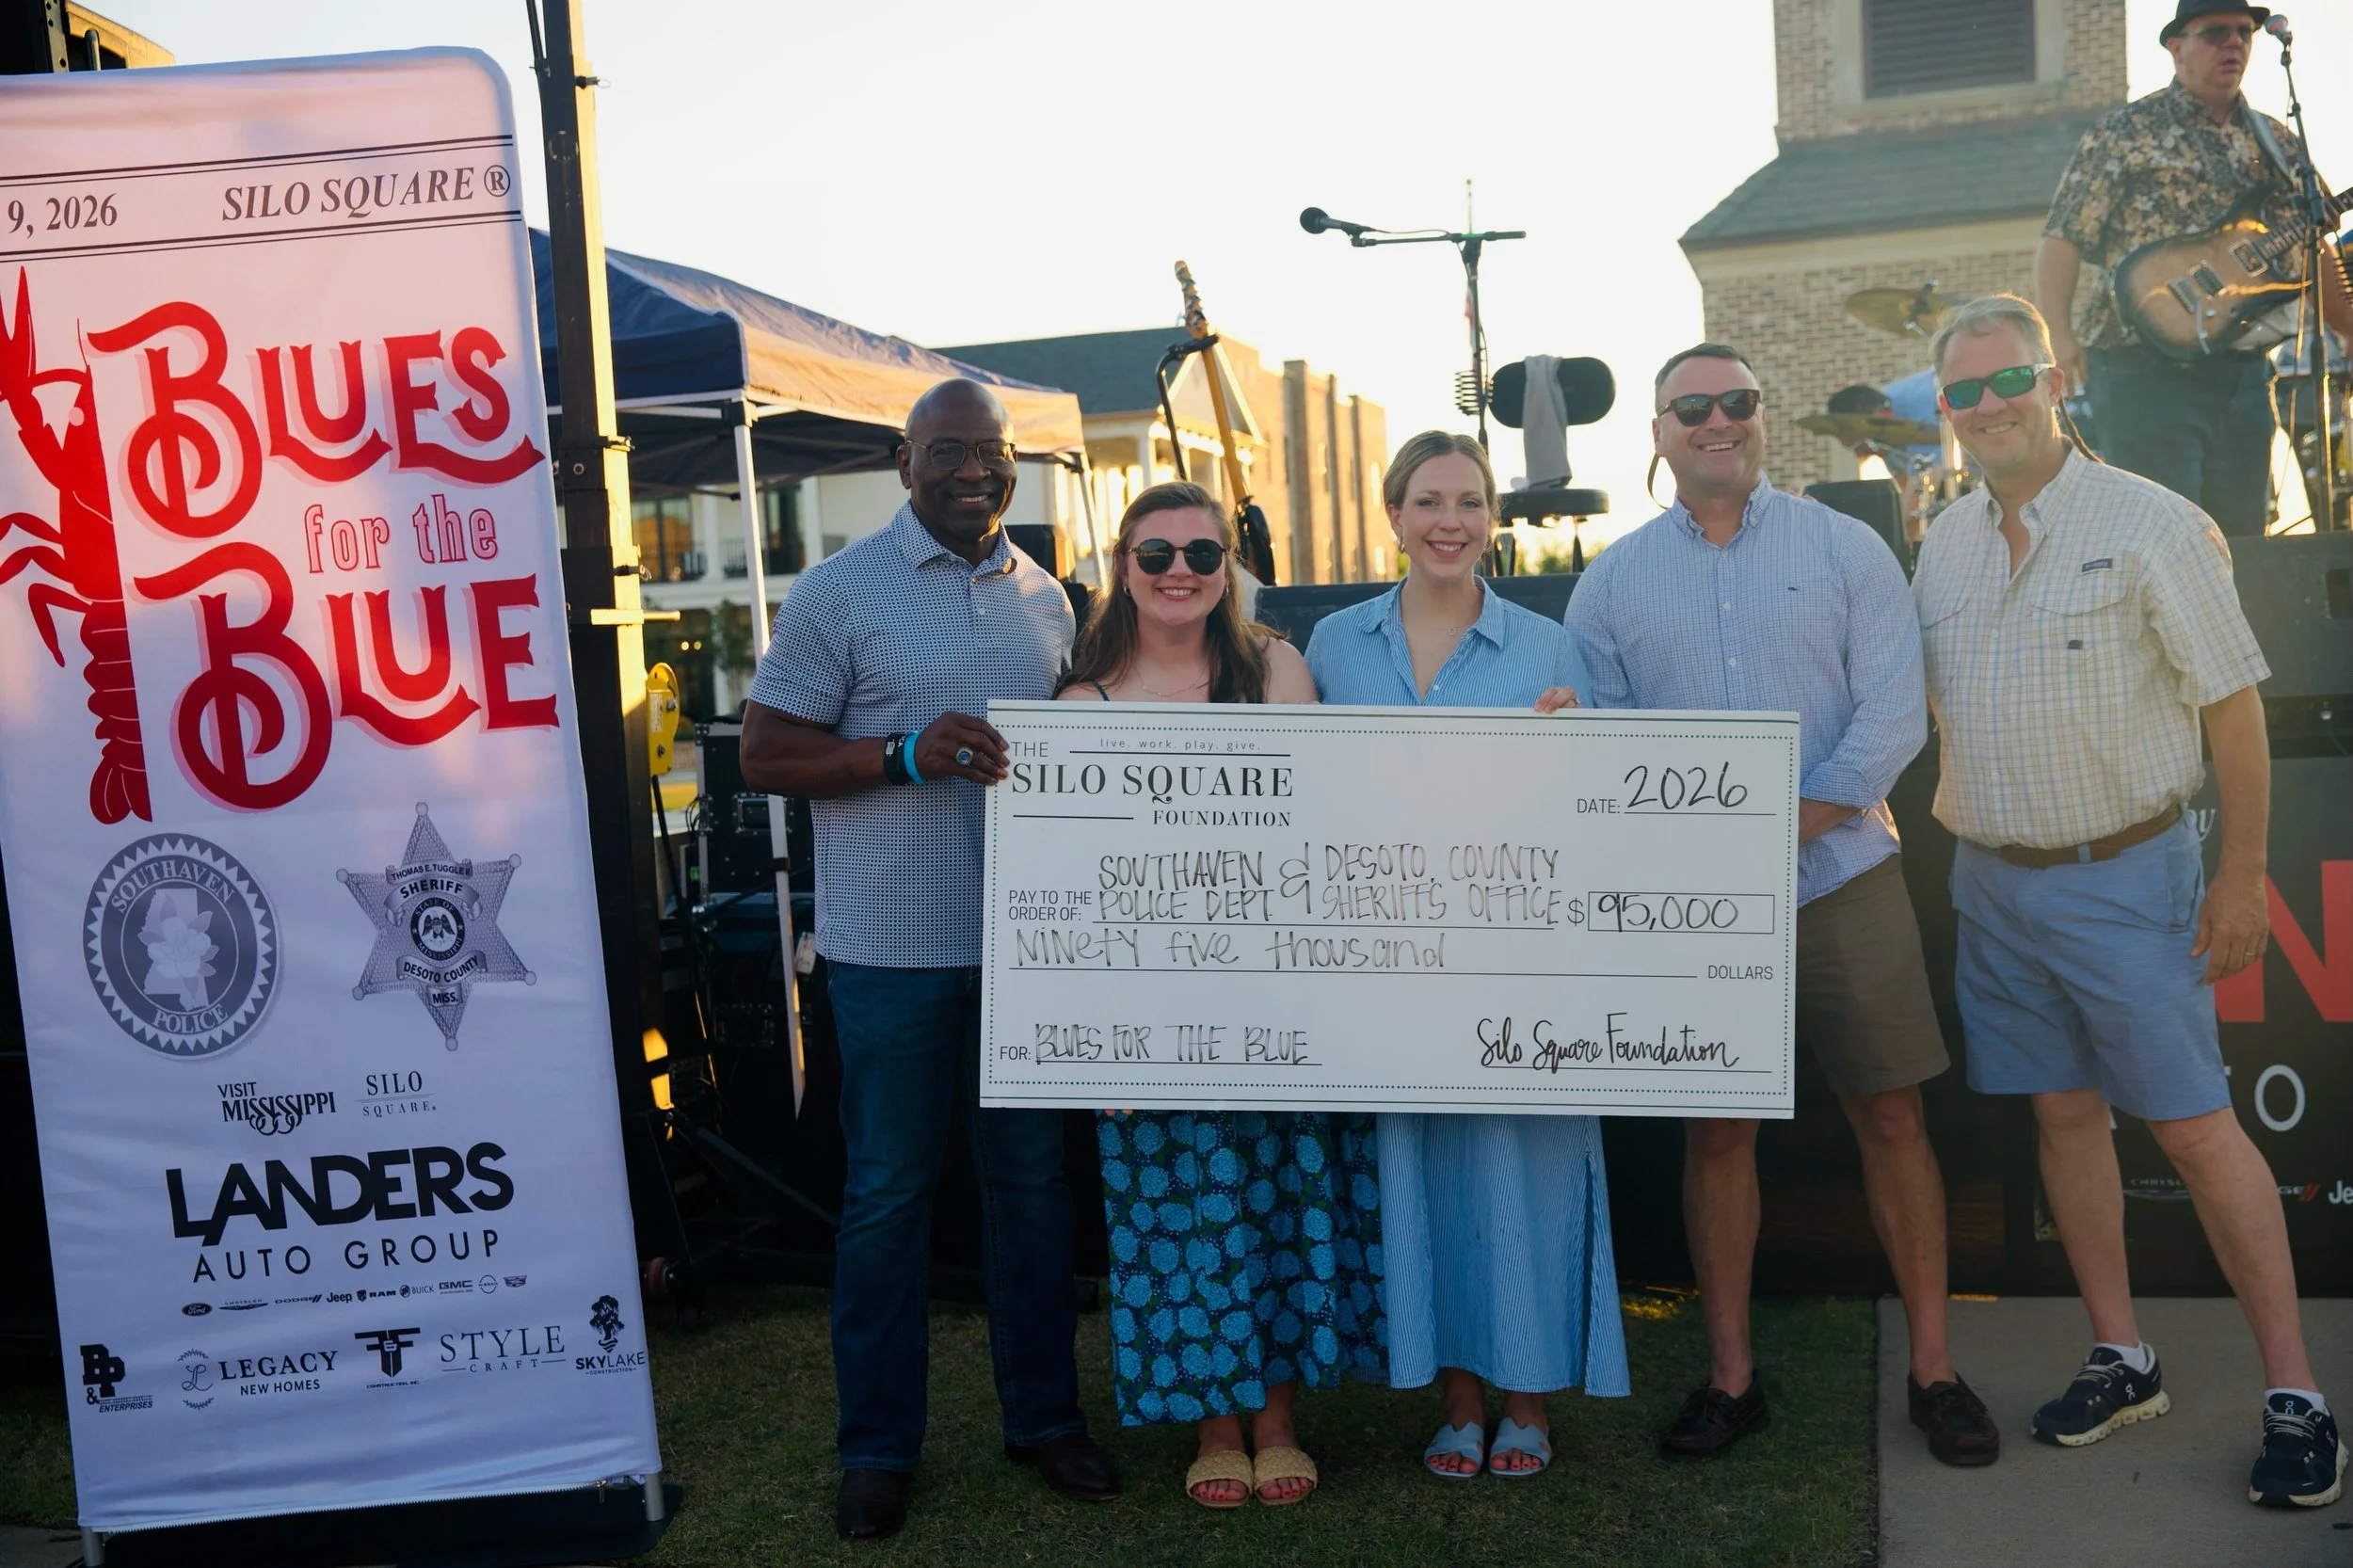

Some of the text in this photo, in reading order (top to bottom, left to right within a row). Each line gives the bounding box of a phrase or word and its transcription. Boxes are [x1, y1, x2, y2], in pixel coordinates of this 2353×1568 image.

[222, 181, 311, 222] SILO
[320, 166, 475, 219] SQUARE
[46, 192, 119, 232] 2026
[304, 493, 500, 574] for the
[133, 541, 561, 811] BLUE
[1011, 741, 1049, 758] THE
[1099, 737, 1262, 752] live. work. play. give.
[1012, 762, 1293, 805] SILO SQUARE
[1624, 760, 1749, 810] 2026
[1152, 809, 1293, 828] FOUNDATION
[1577, 798, 1621, 815] DATE:
[391, 865, 424, 881] THOMAS
[432, 863, 464, 875] TUGGLE
[1098, 849, 1263, 892] SOUTHAVEN
[1324, 842, 1427, 883] DESOTO
[1448, 842, 1560, 883] COUNTY
[111, 859, 235, 913] SOUTHAVEN
[399, 878, 463, 899] SHERIFF
[1008, 889, 1093, 905] PAY TO THE
[442, 901, 454, 911] OF
[1008, 906, 1082, 921] ORDER OF:
[1098, 889, 1190, 922] POLICE
[1467, 883, 1563, 925] OFFICE
[1567, 897, 1586, 927] $
[1597, 893, 1739, 933] 95,000
[1264, 931, 1446, 970] thousand
[404, 954, 479, 984] DESOTO COUNTY
[1706, 965, 1774, 982] DOLLARS
[432, 991, 458, 1004] MISS.
[151, 1003, 230, 1034] POLICE
[999, 1045, 1032, 1063] FOR:
[1034, 1022, 1309, 1065] BLUES FOR THE BLUE
[1476, 1011, 1741, 1075] Silo Square Foundation
[217, 1081, 257, 1099] VISIT
[365, 1070, 424, 1096] SILO
[221, 1091, 337, 1136] MISSISSIPPI
[165, 1142, 515, 1247] LANDERS
[2130, 1177, 2185, 1187] CHRYSL
[193, 1229, 499, 1284] AUTO GROUP
[326, 1291, 353, 1304] Jeep
[369, 1288, 396, 1299] RAM
[411, 1284, 435, 1295] BUICK
[439, 1279, 473, 1290] GMC
[439, 1325, 567, 1363] STYLE
[217, 1350, 339, 1381] LEGACY
[470, 1357, 539, 1373] CRAFT
[239, 1378, 321, 1397] NEW HOMES
[99, 1400, 153, 1414] ENTERPRISES
